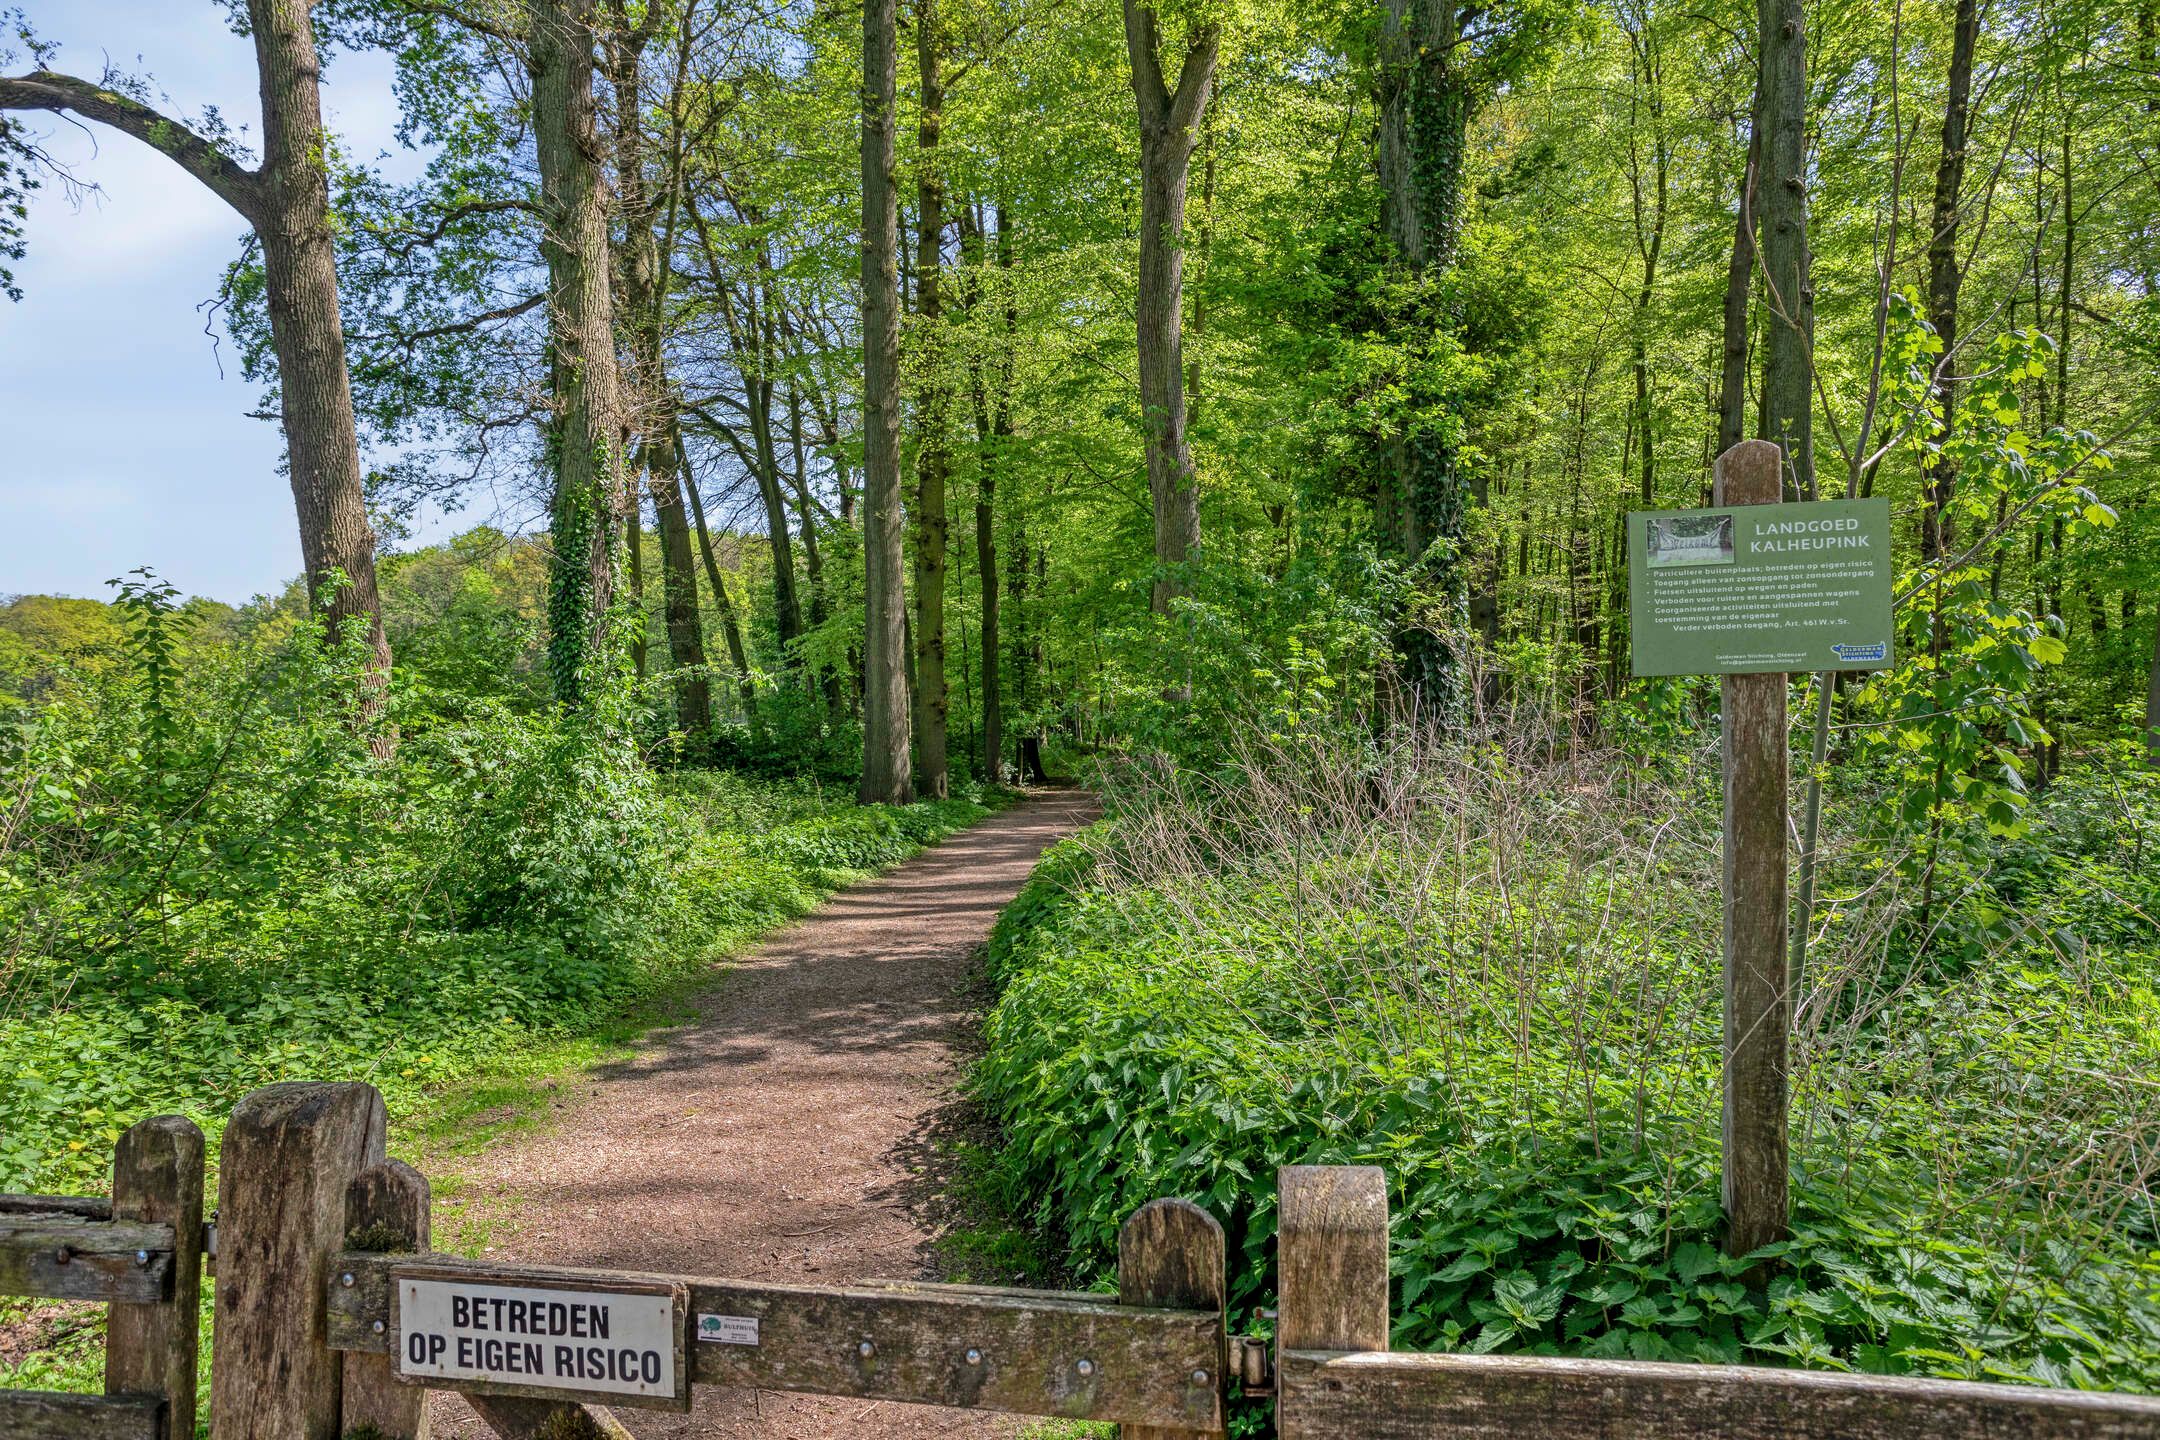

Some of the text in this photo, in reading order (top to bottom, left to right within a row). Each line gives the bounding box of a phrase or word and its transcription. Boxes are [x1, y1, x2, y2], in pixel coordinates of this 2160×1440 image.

[1756, 518, 1858, 535] LANDGOED
[1751, 535, 1870, 552] KALHEUPINK
[1806, 570, 1874, 579] zonsondergang
[1655, 596, 1694, 605] Verboden
[1760, 592, 1823, 600] aangespannen
[1655, 606, 1720, 614] Georganiseerde
[1723, 602, 1770, 610] activiteiten
[1702, 622, 1742, 630] verboden
[452, 1294, 610, 1339] BETREDEN
[408, 1332, 662, 1384] OP EIGEN RISICO
